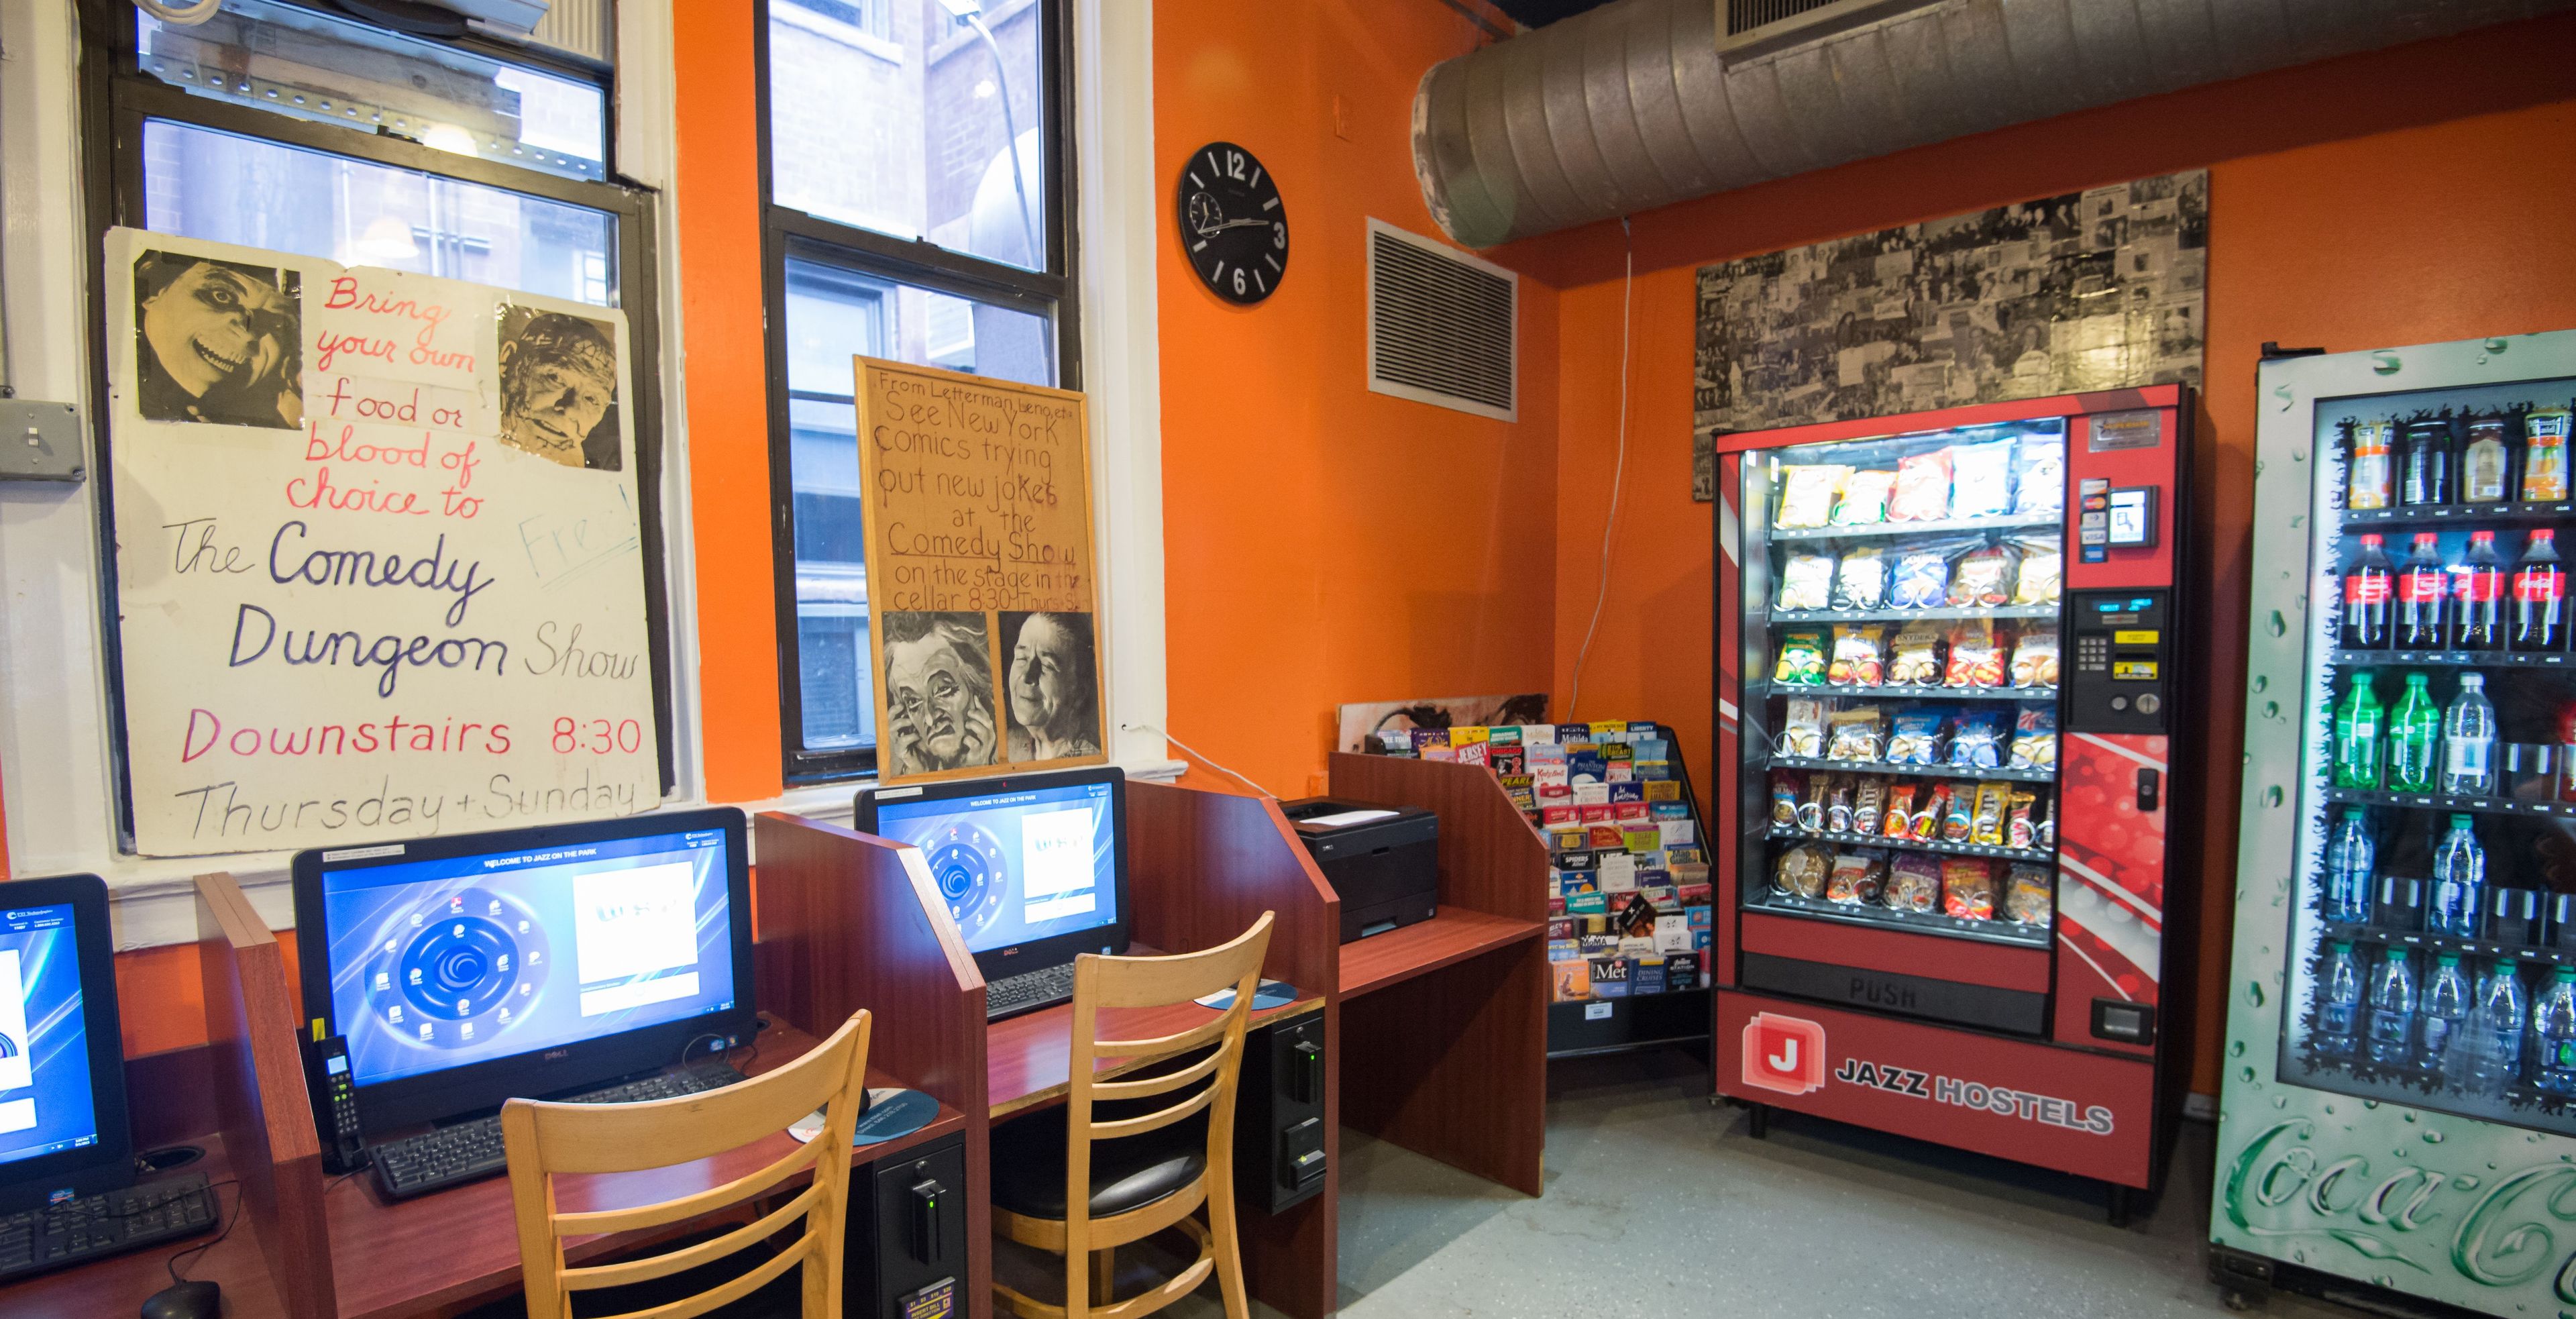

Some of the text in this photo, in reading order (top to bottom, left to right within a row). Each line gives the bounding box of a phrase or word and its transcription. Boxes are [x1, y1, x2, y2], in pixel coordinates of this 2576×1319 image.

[1227, 150, 1245, 180] 12
[1273, 222, 1285, 250] 3
[1234, 268, 1246, 295] 6
[325, 278, 451, 339] Bring
[317, 329, 476, 372] your own
[880, 372, 926, 396] From
[327, 377, 464, 428] food or
[886, 390, 941, 425] See
[949, 401, 999, 434] New
[307, 424, 481, 487] blood of
[982, 437, 1051, 485] trying
[286, 467, 484, 519] choice to
[879, 468, 926, 495] out
[937, 473, 984, 498] new
[953, 504, 1036, 532] at the
[888, 522, 1075, 572] Comedy Show
[163, 518, 255, 574] The
[270, 521, 494, 628] Comedy
[896, 566, 925, 585] on
[933, 559, 968, 585] the
[973, 565, 1031, 599] stage
[1036, 570, 1051, 589] in
[894, 585, 961, 611] cellar
[969, 588, 1011, 611] 8:30
[230, 603, 639, 698] Dungeon Show
[182, 709, 641, 763] Downstairs 8:30
[1561, 734, 1589, 742] Matilda
[1458, 741, 1487, 763] JERSEY
[484, 857, 521, 868] WELCOME
[523, 855, 533, 863] TO
[534, 853, 551, 862] JAZZ
[564, 850, 577, 858] THE
[578, 848, 597, 857] PARK
[1582, 939, 1607, 947] MoMA
[1596, 964, 1627, 979] Met
[1849, 978, 1917, 1007] PUSH
[545, 1049, 569, 1060] DELL
[1768, 1038, 1798, 1071] J
[1835, 1058, 2114, 1135] JAZZ HOSTELS
